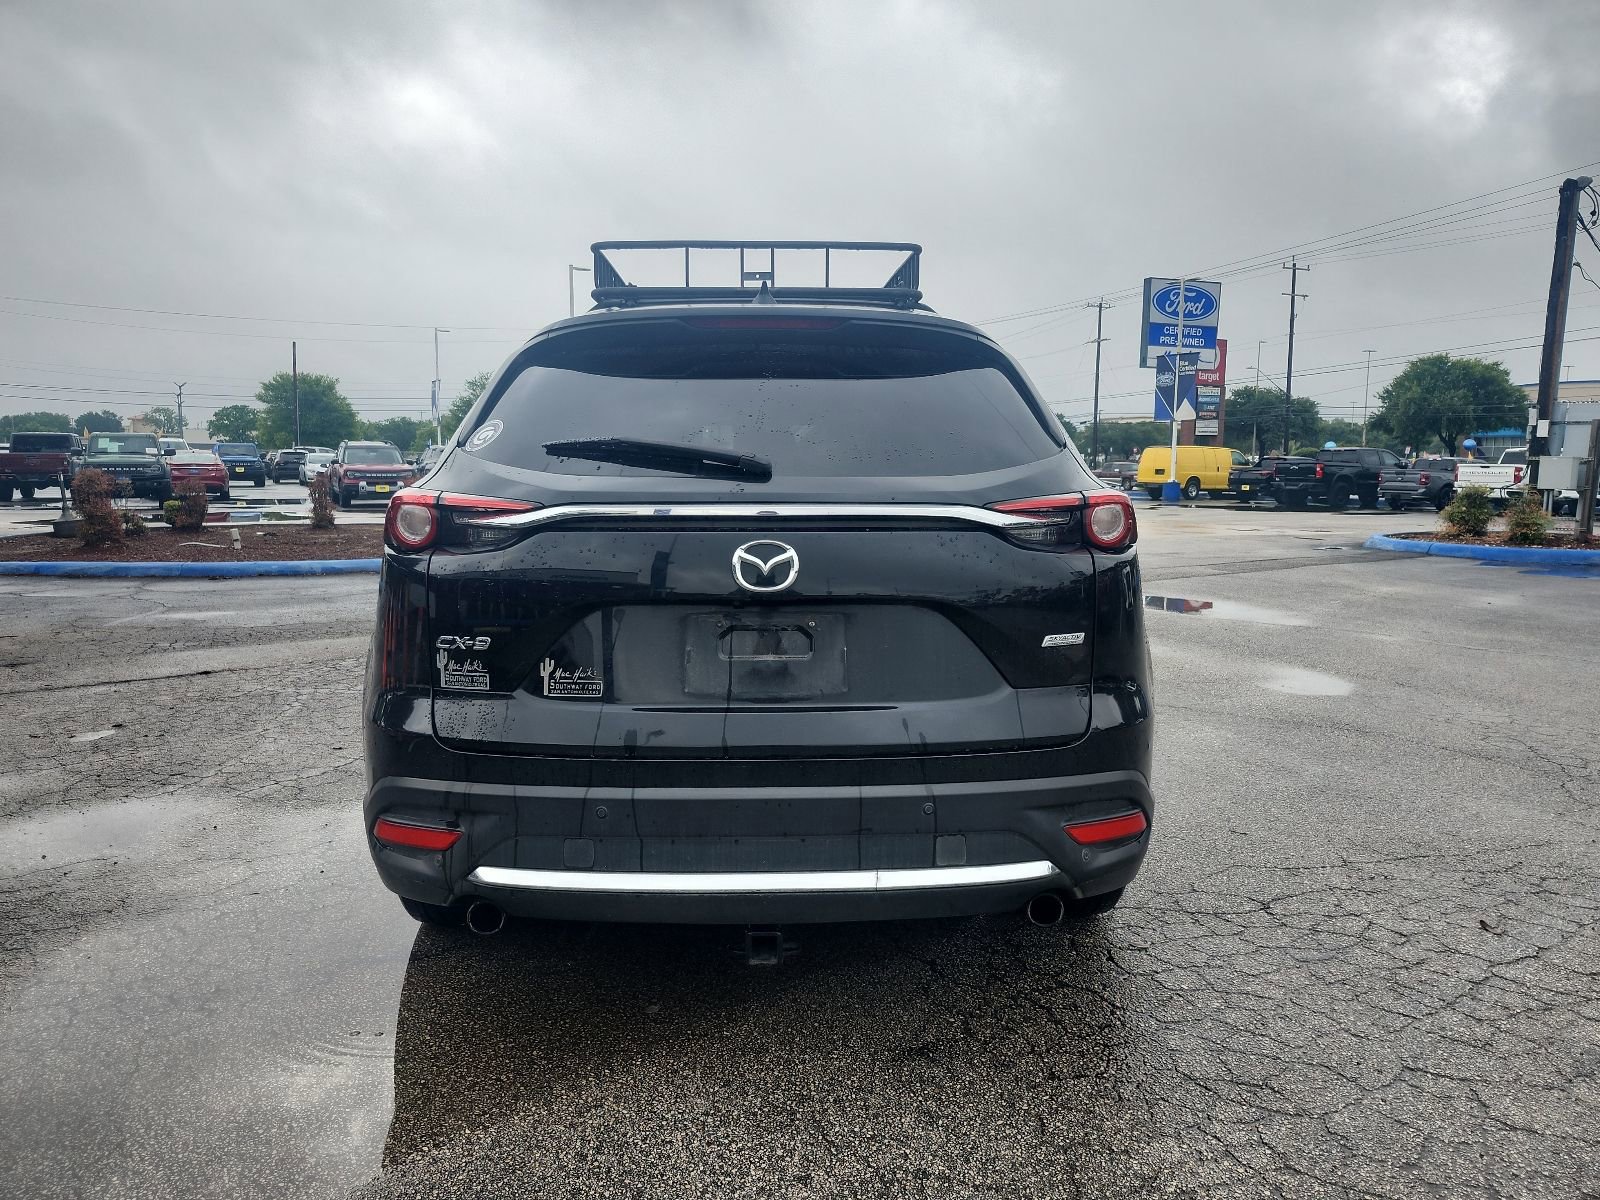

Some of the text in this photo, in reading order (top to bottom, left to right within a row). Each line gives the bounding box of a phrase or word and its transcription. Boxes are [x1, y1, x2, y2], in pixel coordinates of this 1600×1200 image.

[1165, 289, 1206, 315] Frd
[1159, 336, 1205, 346] PRE-WNED
[1198, 371, 1220, 382] target
[436, 635, 491, 650] CX-9
[550, 679, 583, 690] SOUTHWAY
